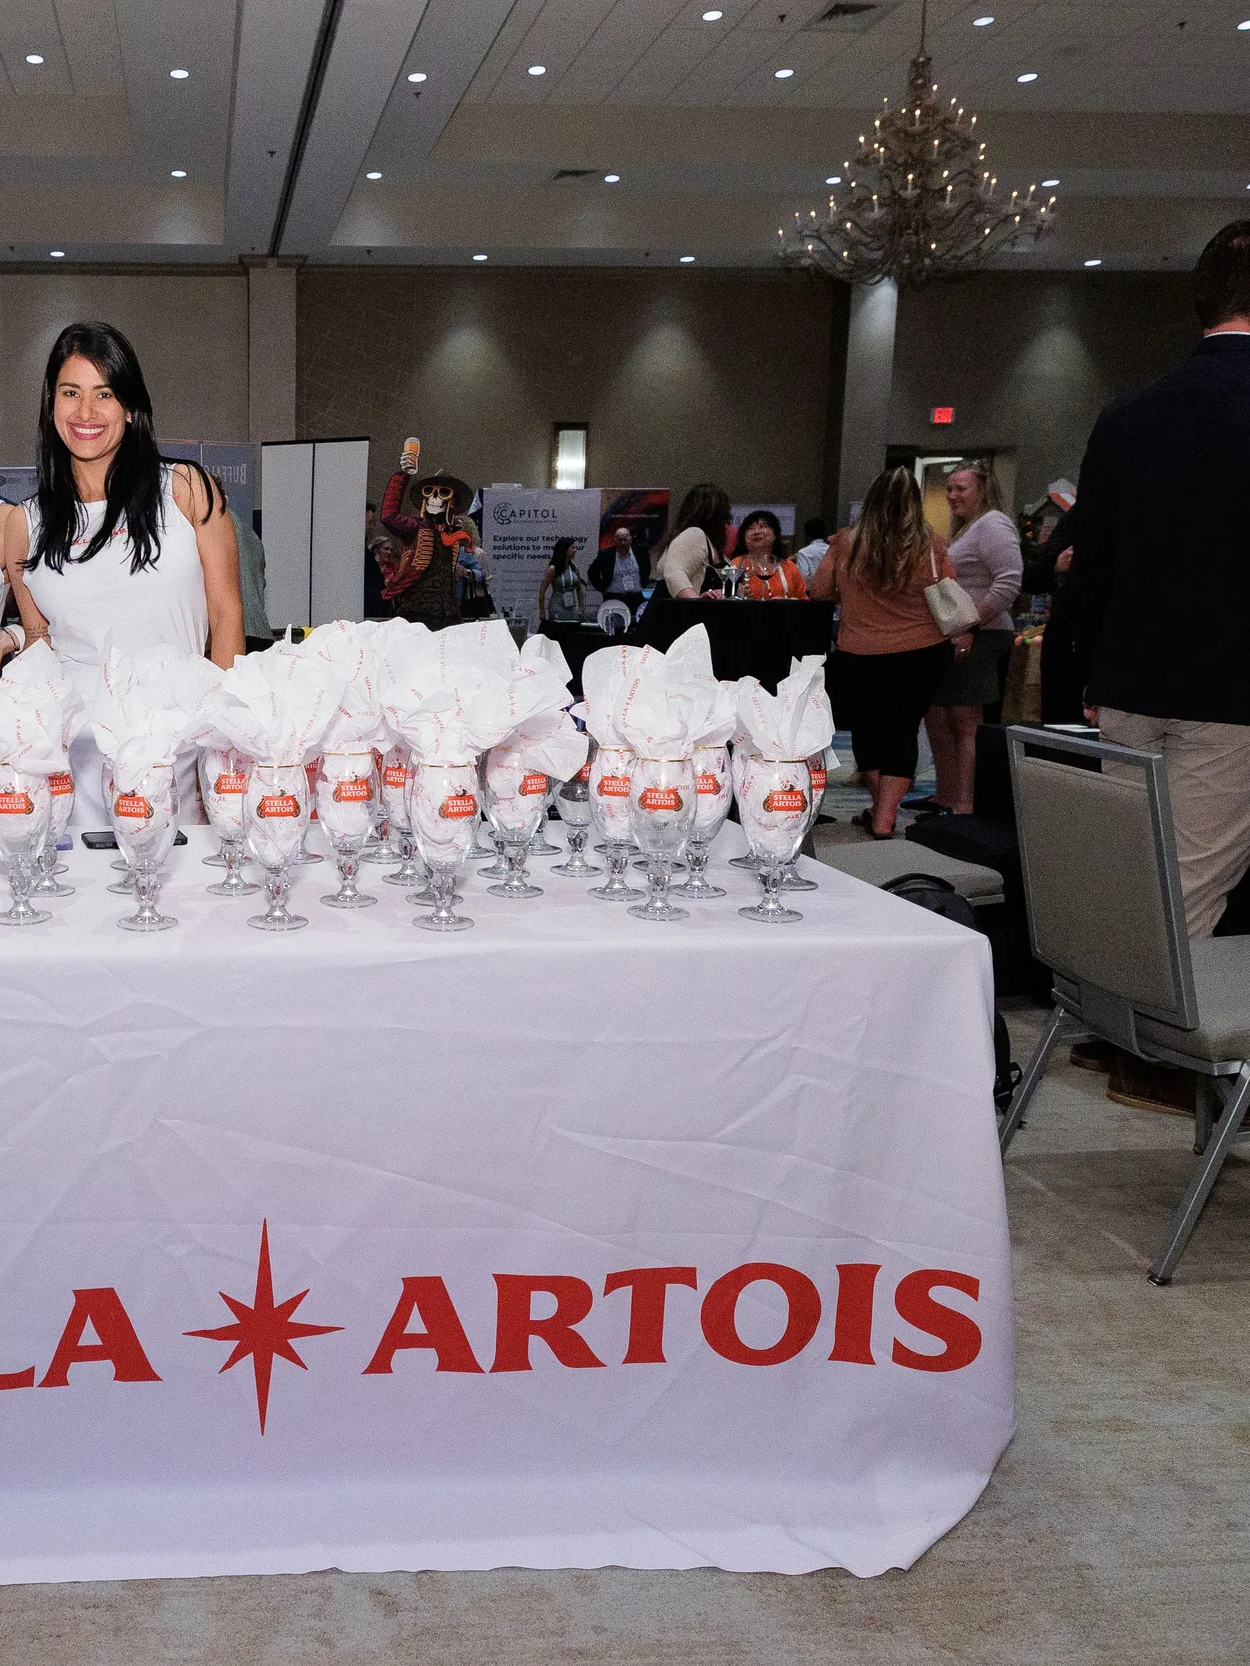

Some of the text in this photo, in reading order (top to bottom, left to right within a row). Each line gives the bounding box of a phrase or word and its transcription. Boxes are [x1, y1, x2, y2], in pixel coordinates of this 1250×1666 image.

[500, 508, 558, 518] CAPITOL
[493, 534, 524, 543] Explore
[492, 543, 530, 551] solutions
[628, 678, 641, 702] ARTOIS
[360, 1262, 982, 1374] ARTOIS
